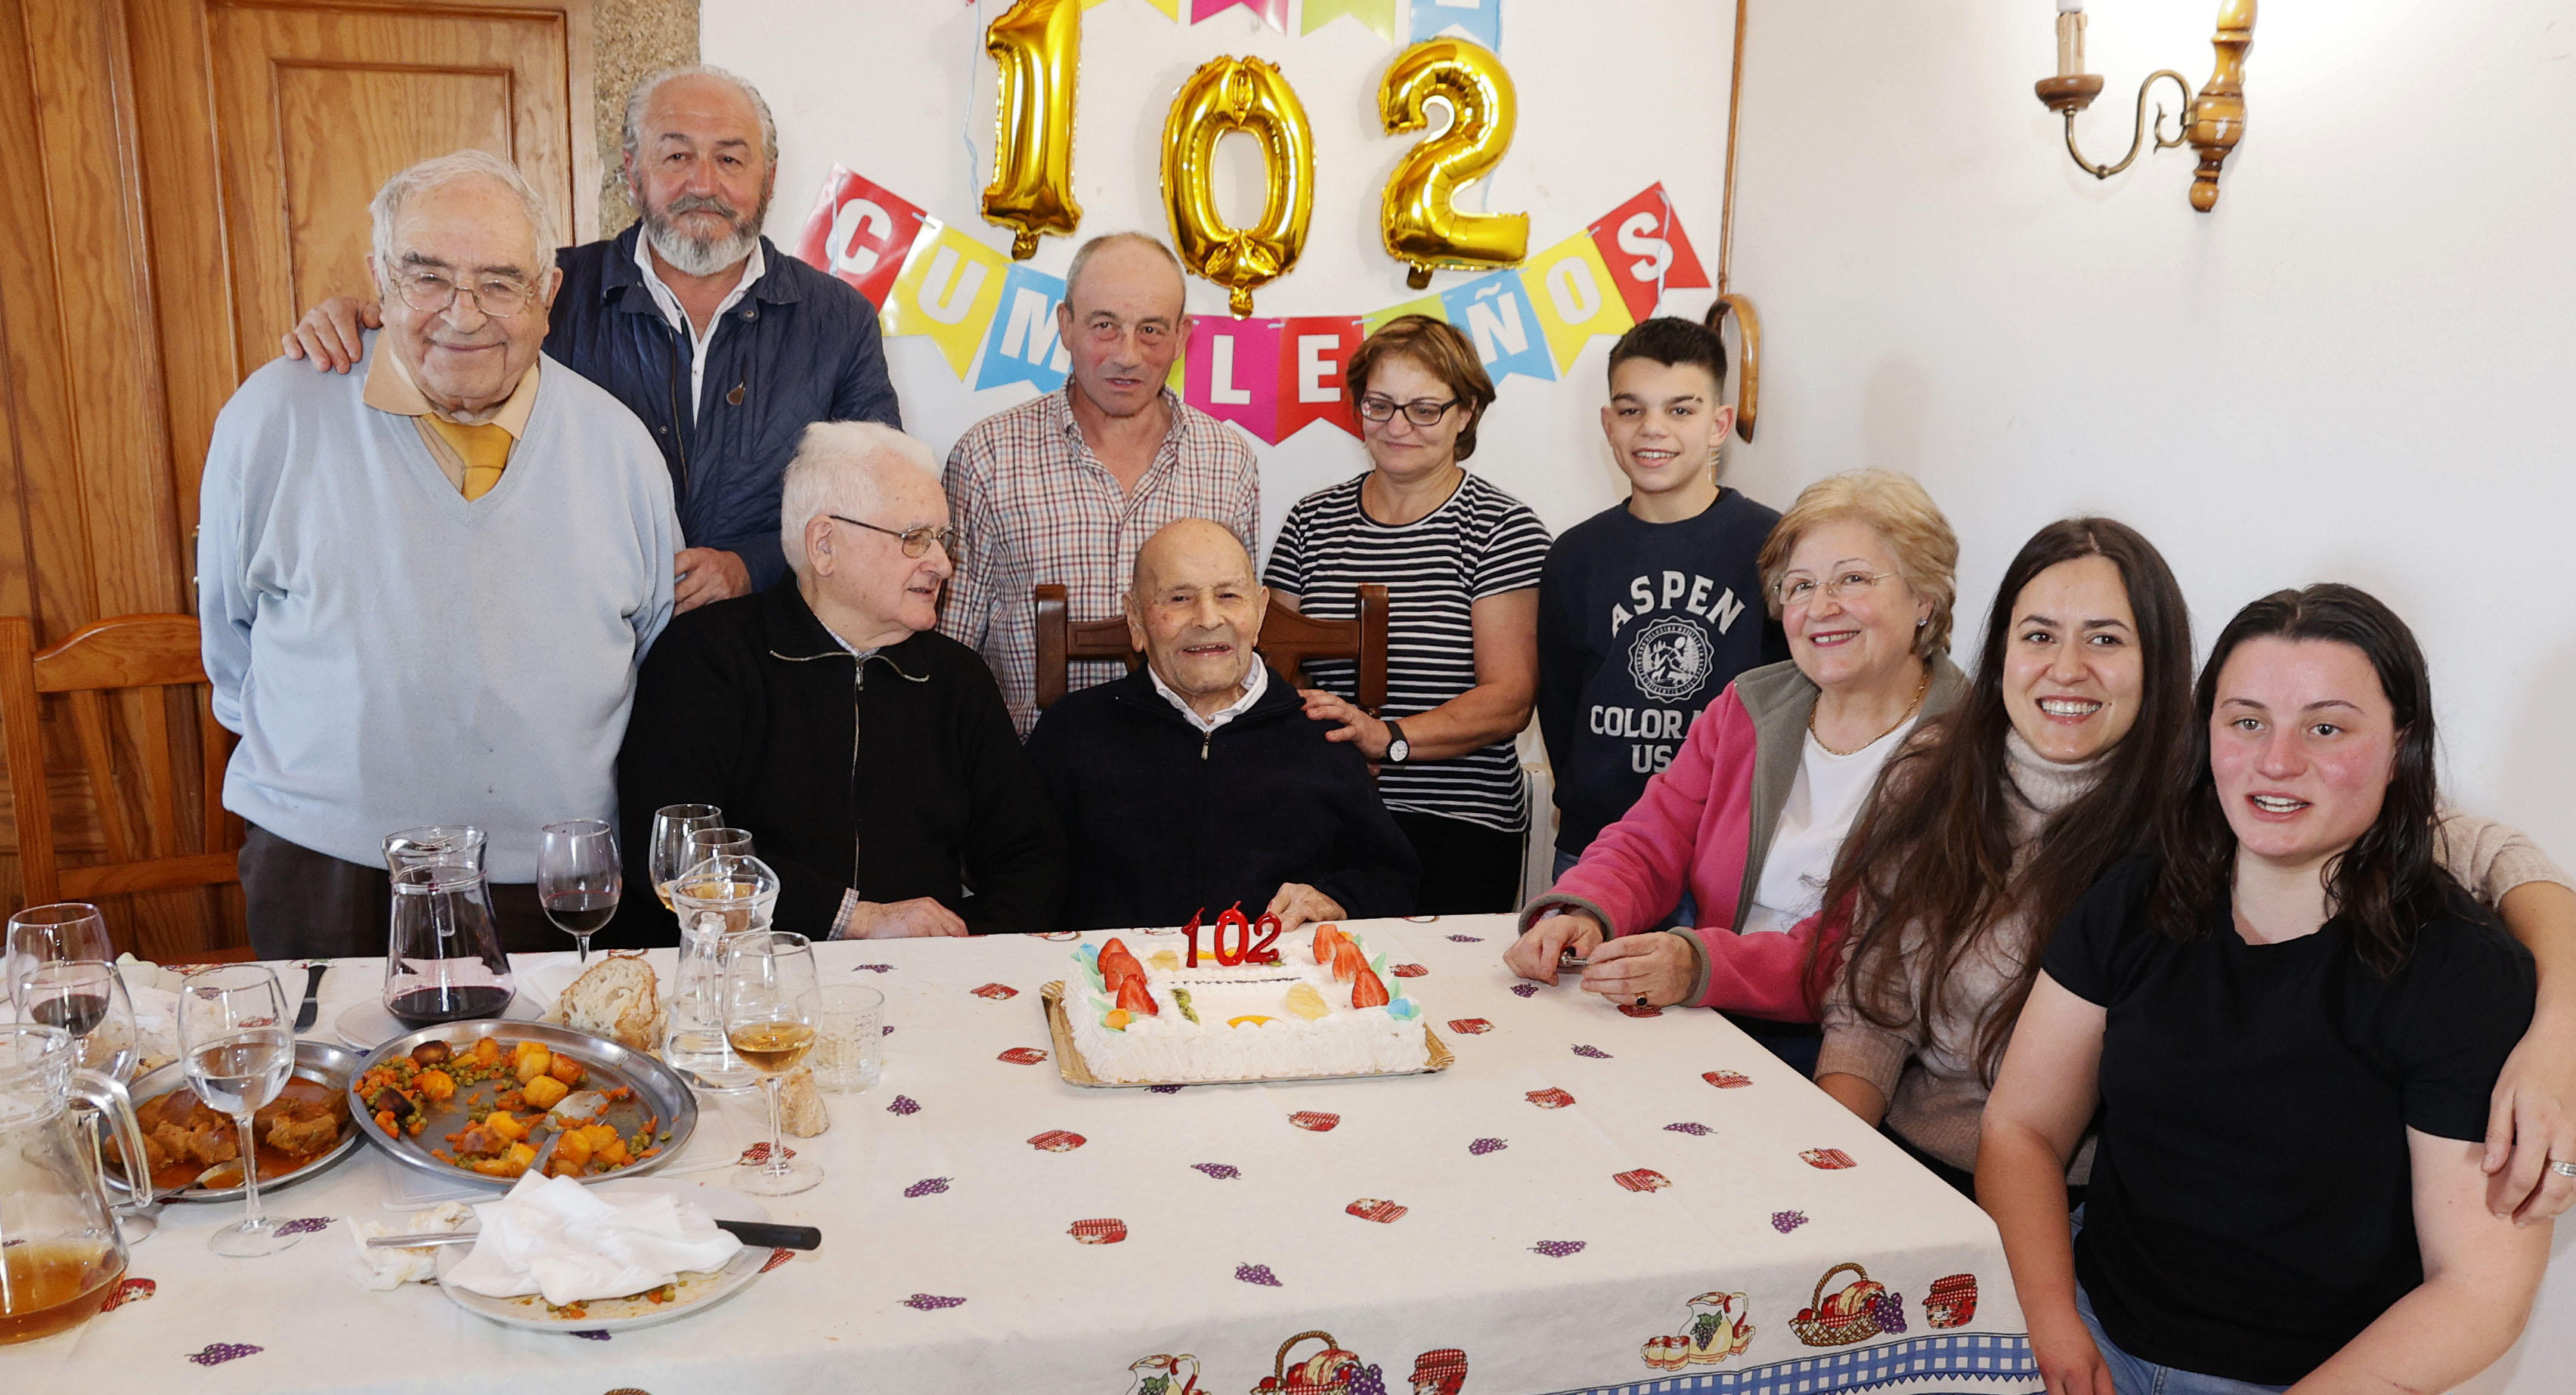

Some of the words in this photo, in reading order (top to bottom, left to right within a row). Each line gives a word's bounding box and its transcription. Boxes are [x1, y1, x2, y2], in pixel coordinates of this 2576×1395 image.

[980, 0, 1531, 293] 102
[825, 197, 1674, 406] CUMLEÑOS
[1612, 571, 1746, 639] ASPEN
[1630, 744, 1673, 774] US
[1181, 902, 1283, 969] 102
